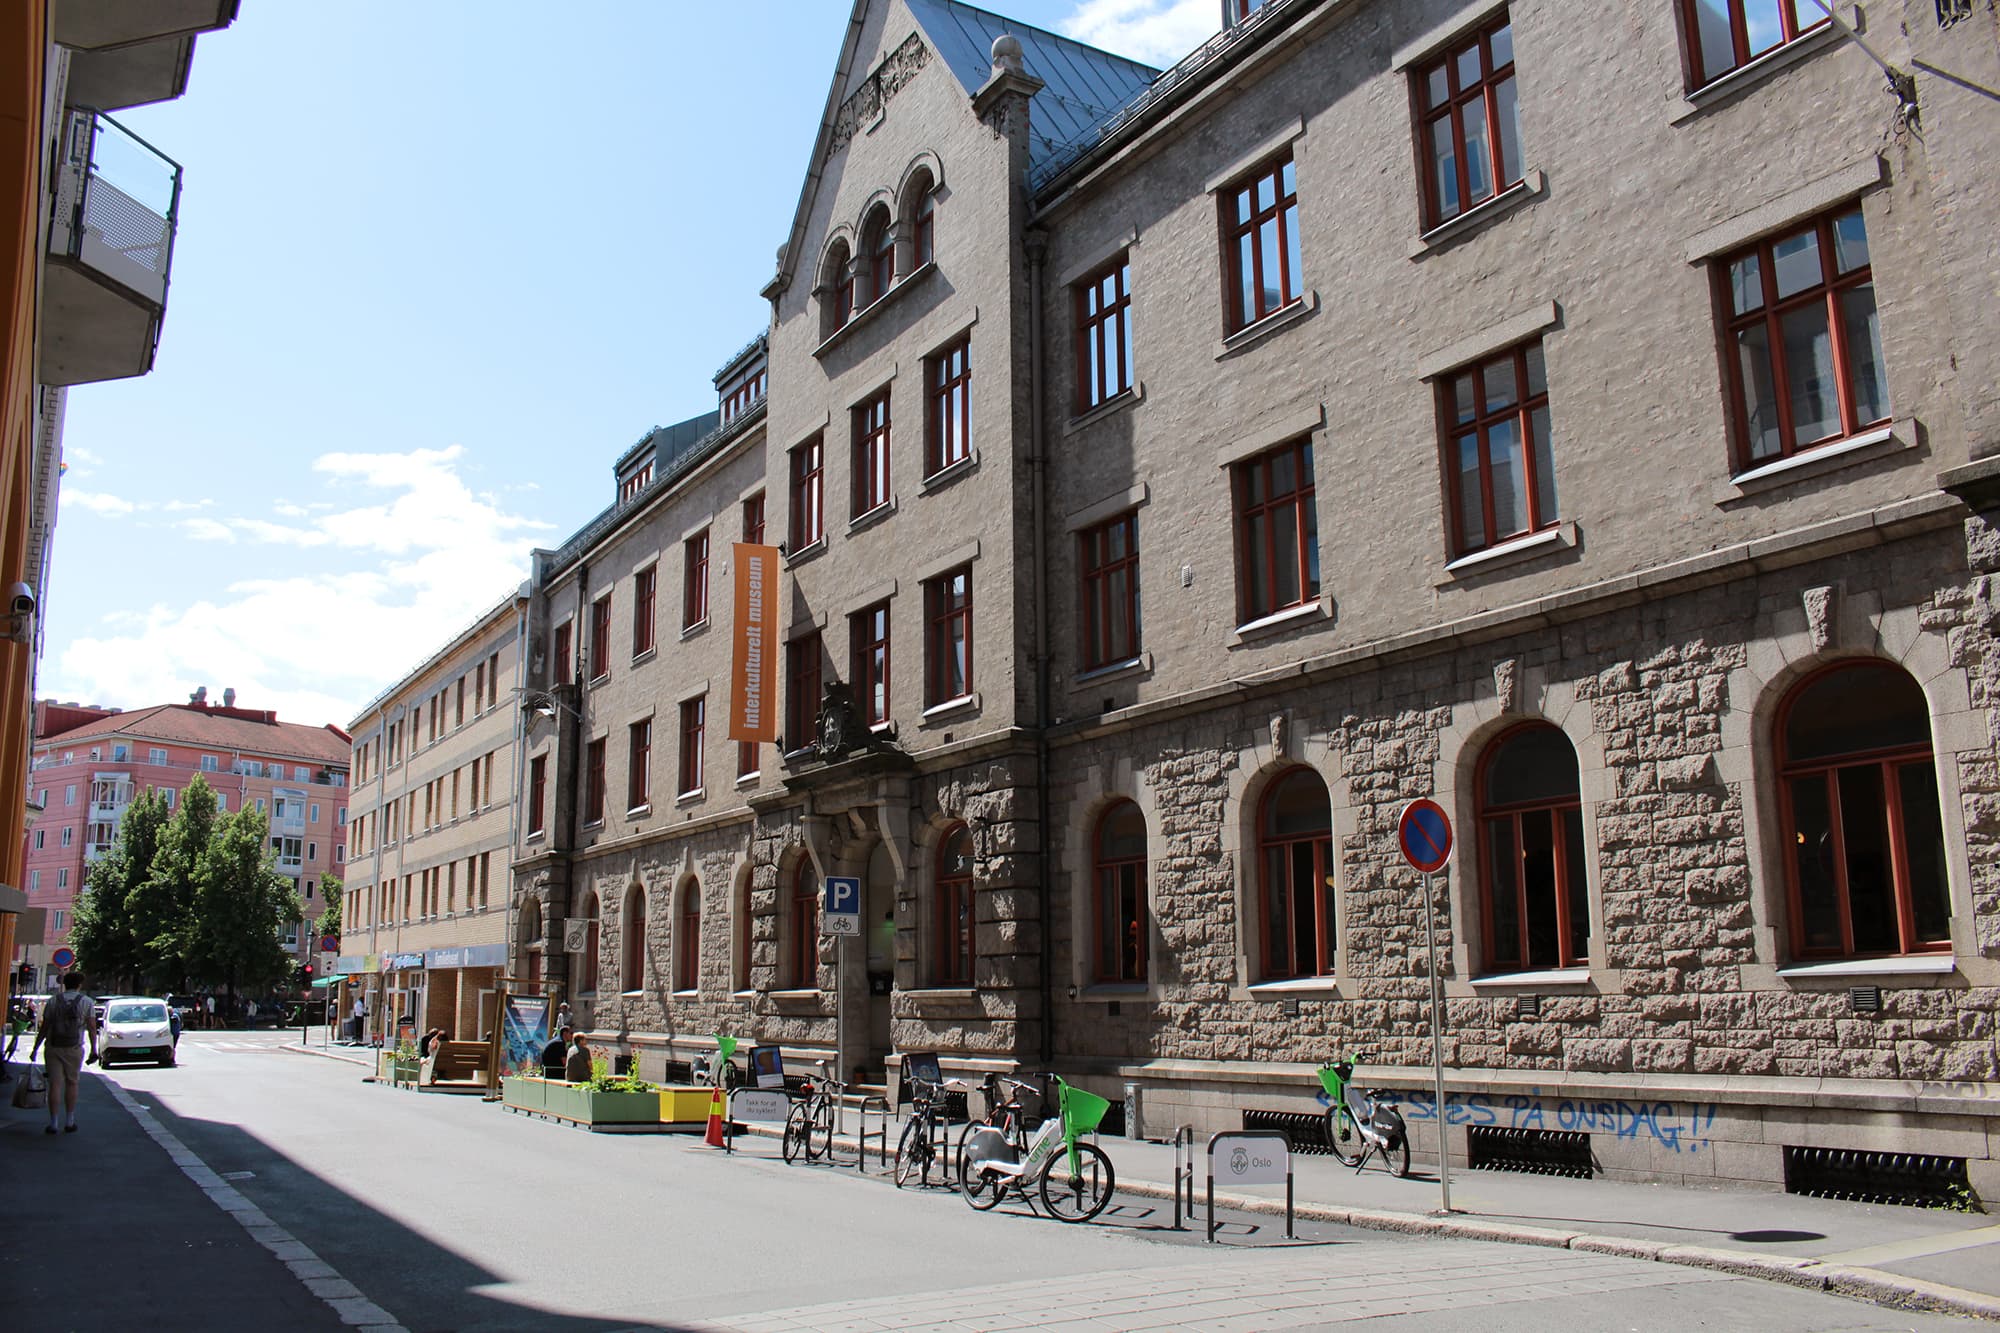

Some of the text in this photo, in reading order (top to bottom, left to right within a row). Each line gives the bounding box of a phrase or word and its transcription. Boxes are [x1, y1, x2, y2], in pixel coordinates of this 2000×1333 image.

[743, 556, 762, 729] interkulturelt museum
[833, 882, 851, 909] P
[1504, 1087, 1544, 1129] PÅ
[1252, 1157, 1272, 1168] Oslo
